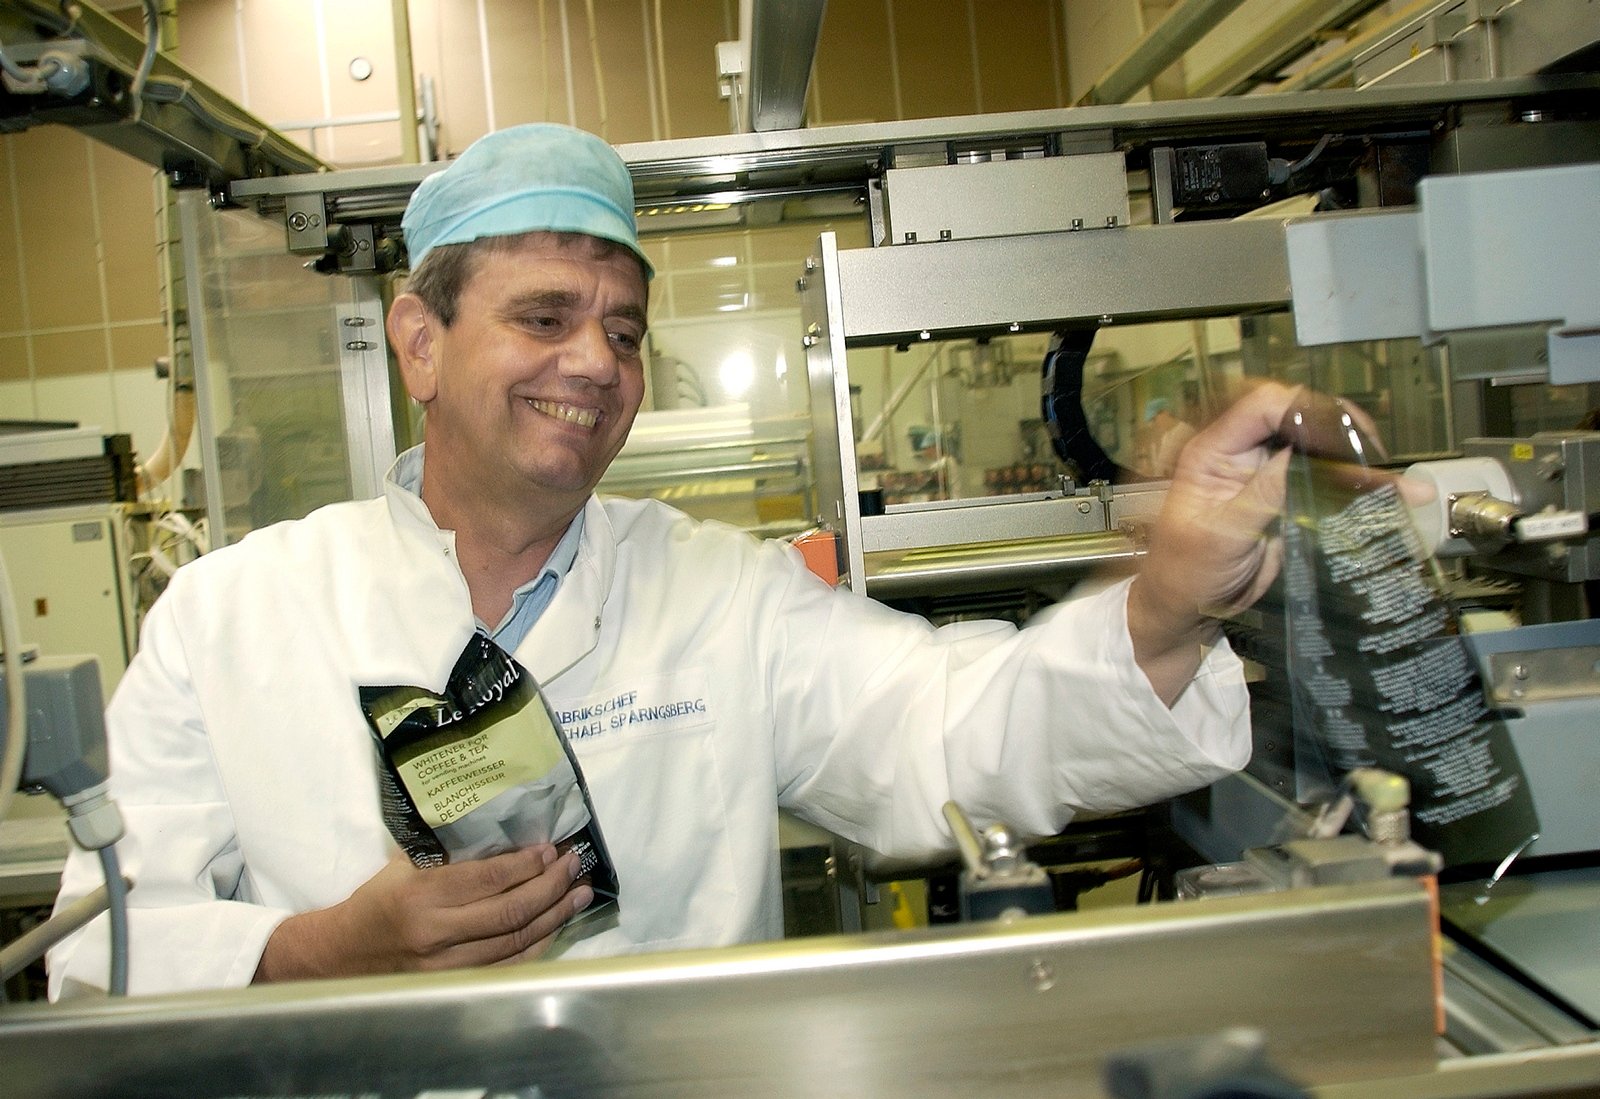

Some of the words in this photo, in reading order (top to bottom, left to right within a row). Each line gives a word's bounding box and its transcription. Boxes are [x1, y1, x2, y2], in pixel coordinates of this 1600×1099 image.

[437, 708, 463, 727] Le
[611, 698, 706, 729] SPARNGSBERG
[413, 743, 466, 770] WHITENER
[467, 733, 489, 747] FOR
[418, 757, 457, 779] COFFEE
[460, 753, 467, 762] &
[468, 744, 489, 757] TEA
[432, 768, 458, 780] vending
[458, 755, 487, 770] machines
[427, 760, 506, 798] KAFFEEWEISSER
[434, 772, 506, 811] BLANCHISSEUR
[440, 809, 454, 822] DE
[455, 793, 480, 813] CAFÉ
